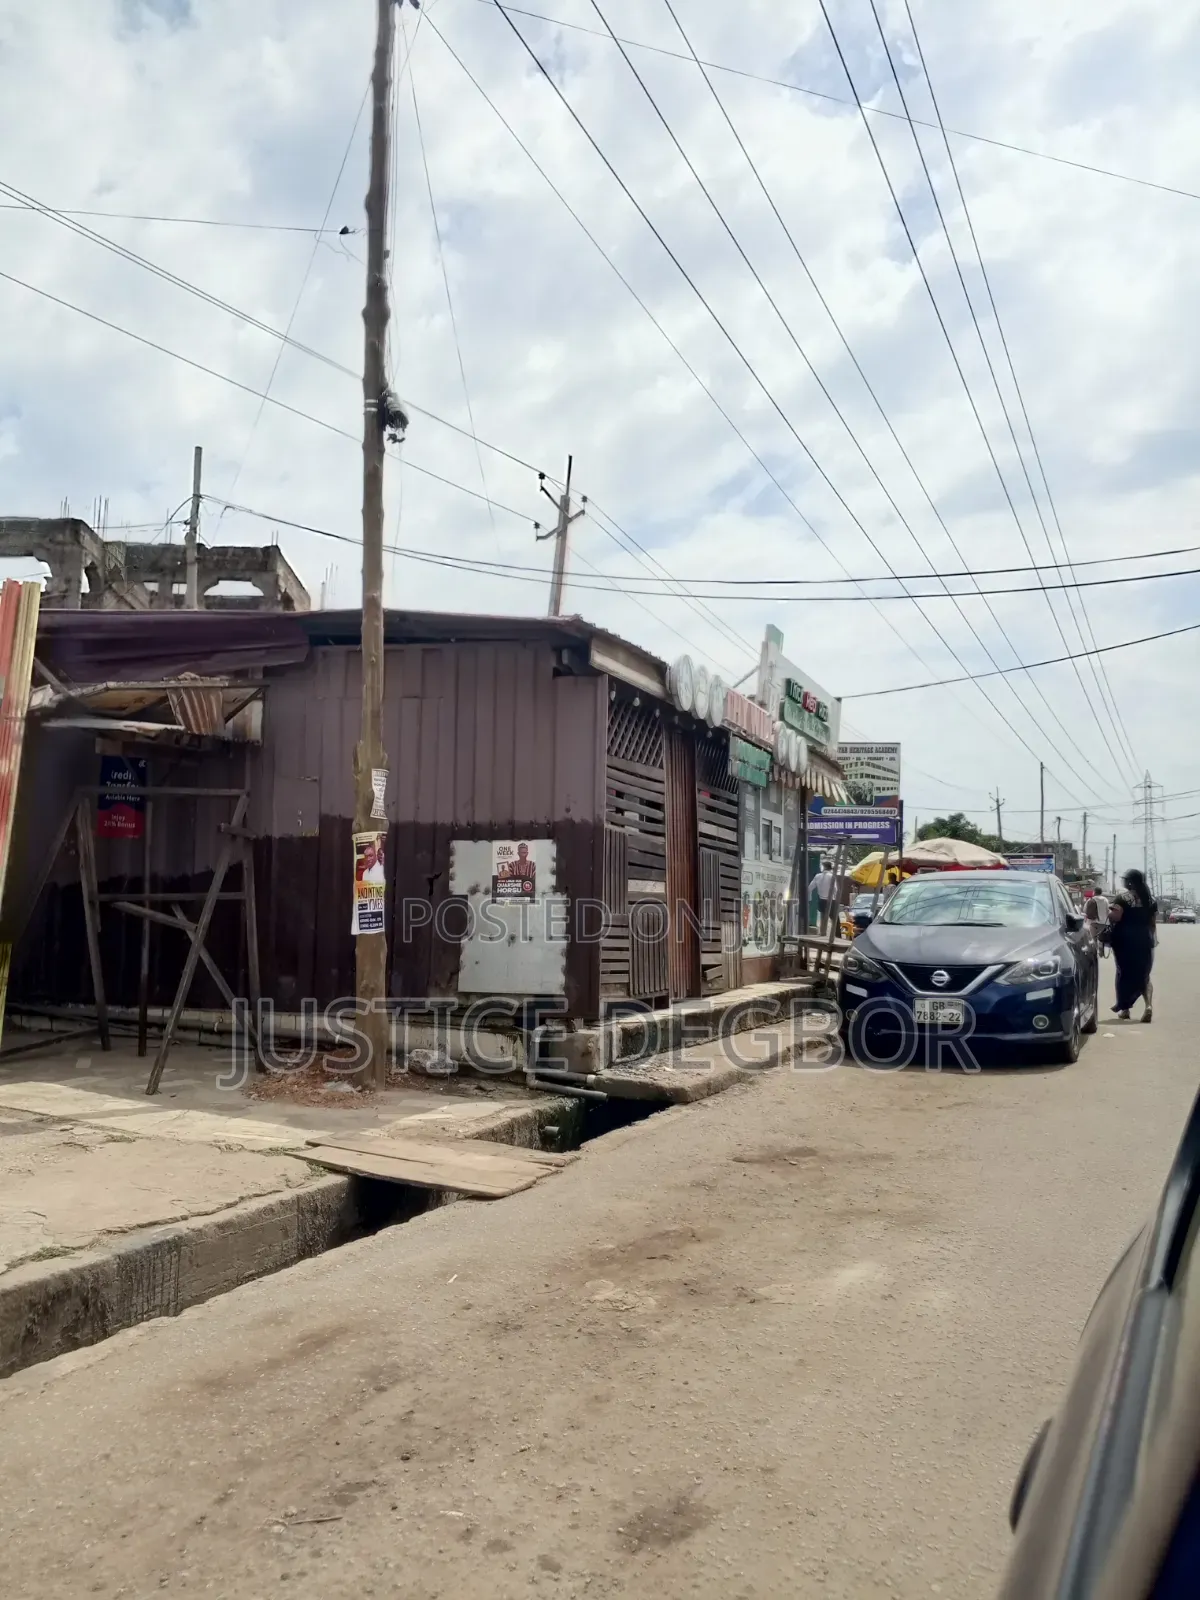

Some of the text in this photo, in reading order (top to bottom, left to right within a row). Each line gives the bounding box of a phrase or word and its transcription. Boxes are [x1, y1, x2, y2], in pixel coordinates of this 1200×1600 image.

[845, 821, 853, 829] IN
[854, 821, 890, 829] PROGRESS
[932, 1001, 946, 1011] GB
[916, 1010, 961, 1021] 7882-22
